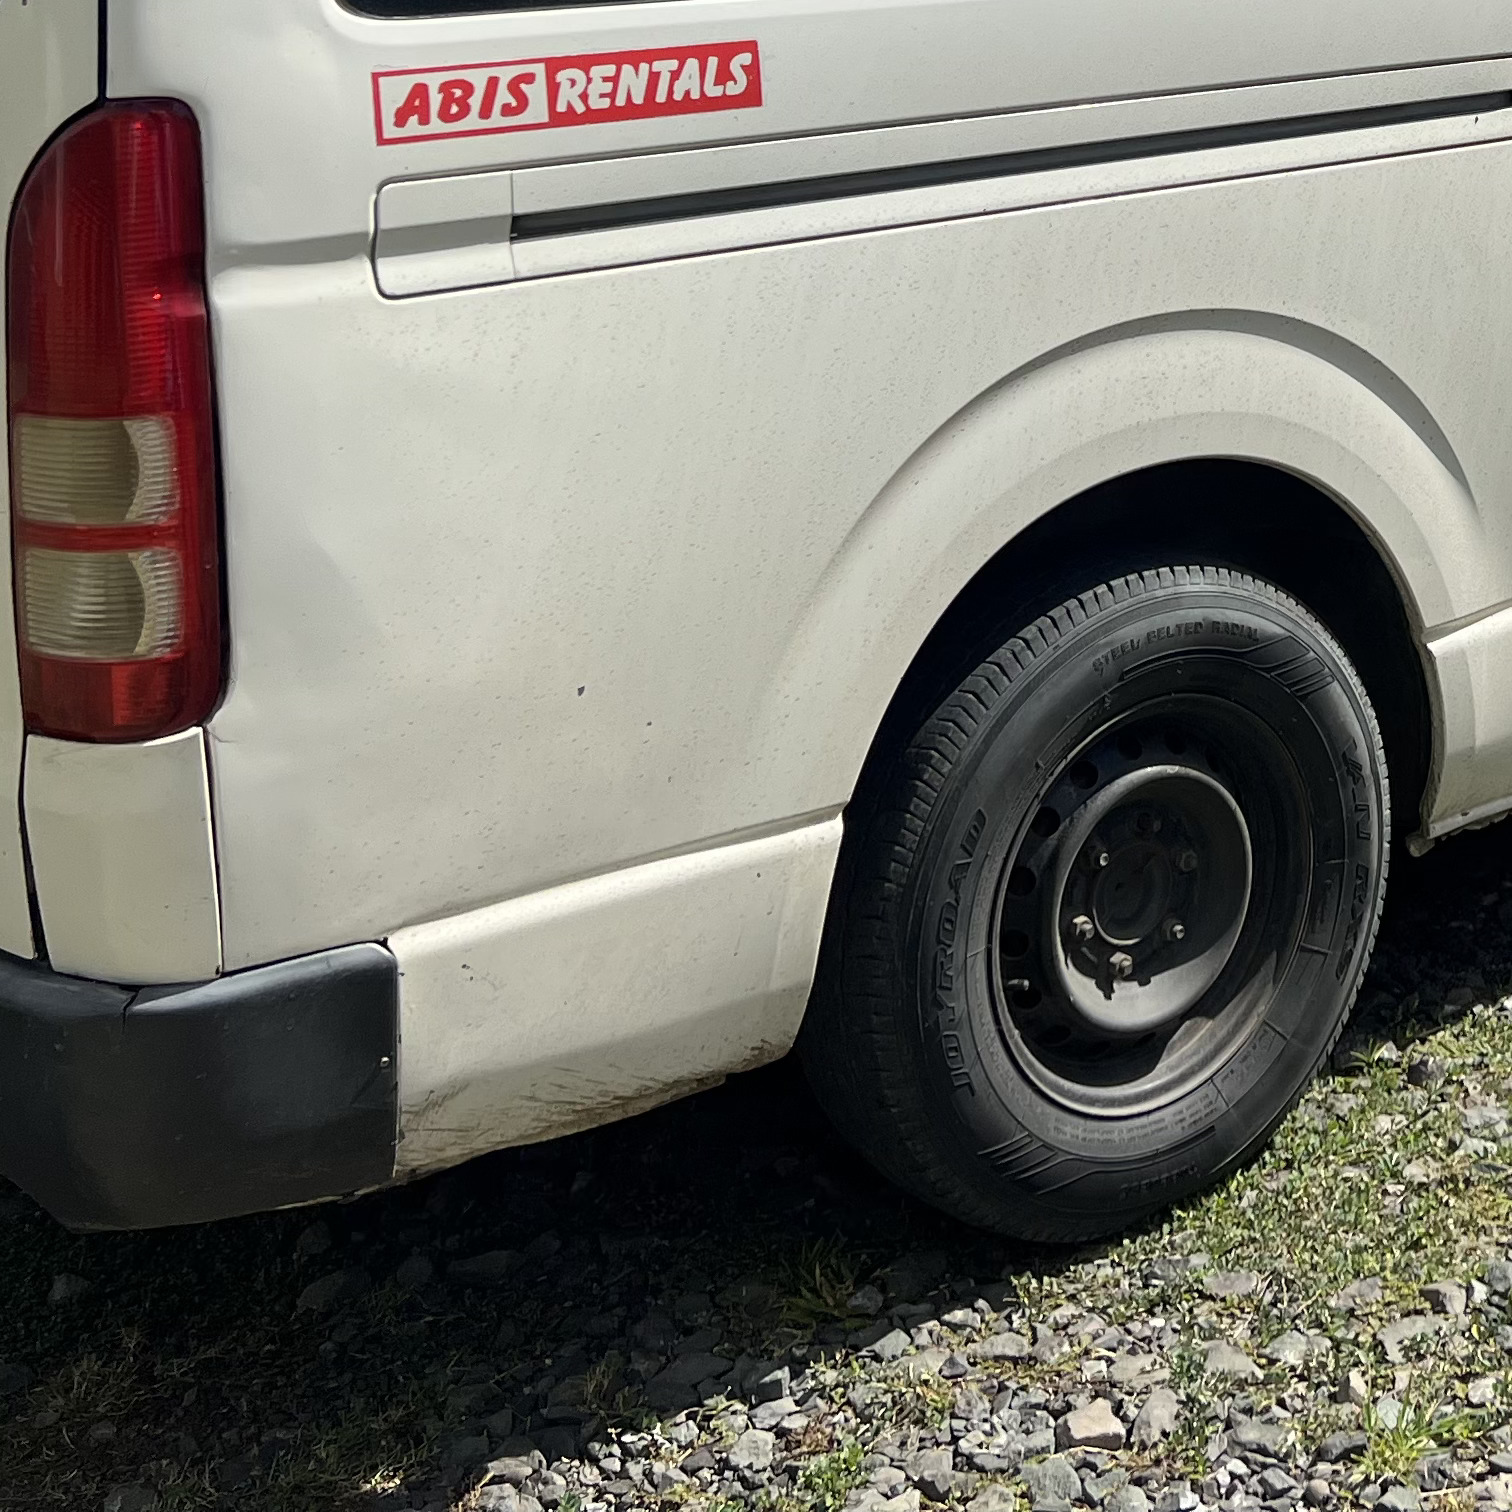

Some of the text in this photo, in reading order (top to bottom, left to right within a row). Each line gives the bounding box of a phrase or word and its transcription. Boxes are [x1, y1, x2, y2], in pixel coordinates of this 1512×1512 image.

[393, 52, 753, 129] ABIS RENTALS
[935, 807, 988, 1098] JOYROAD
